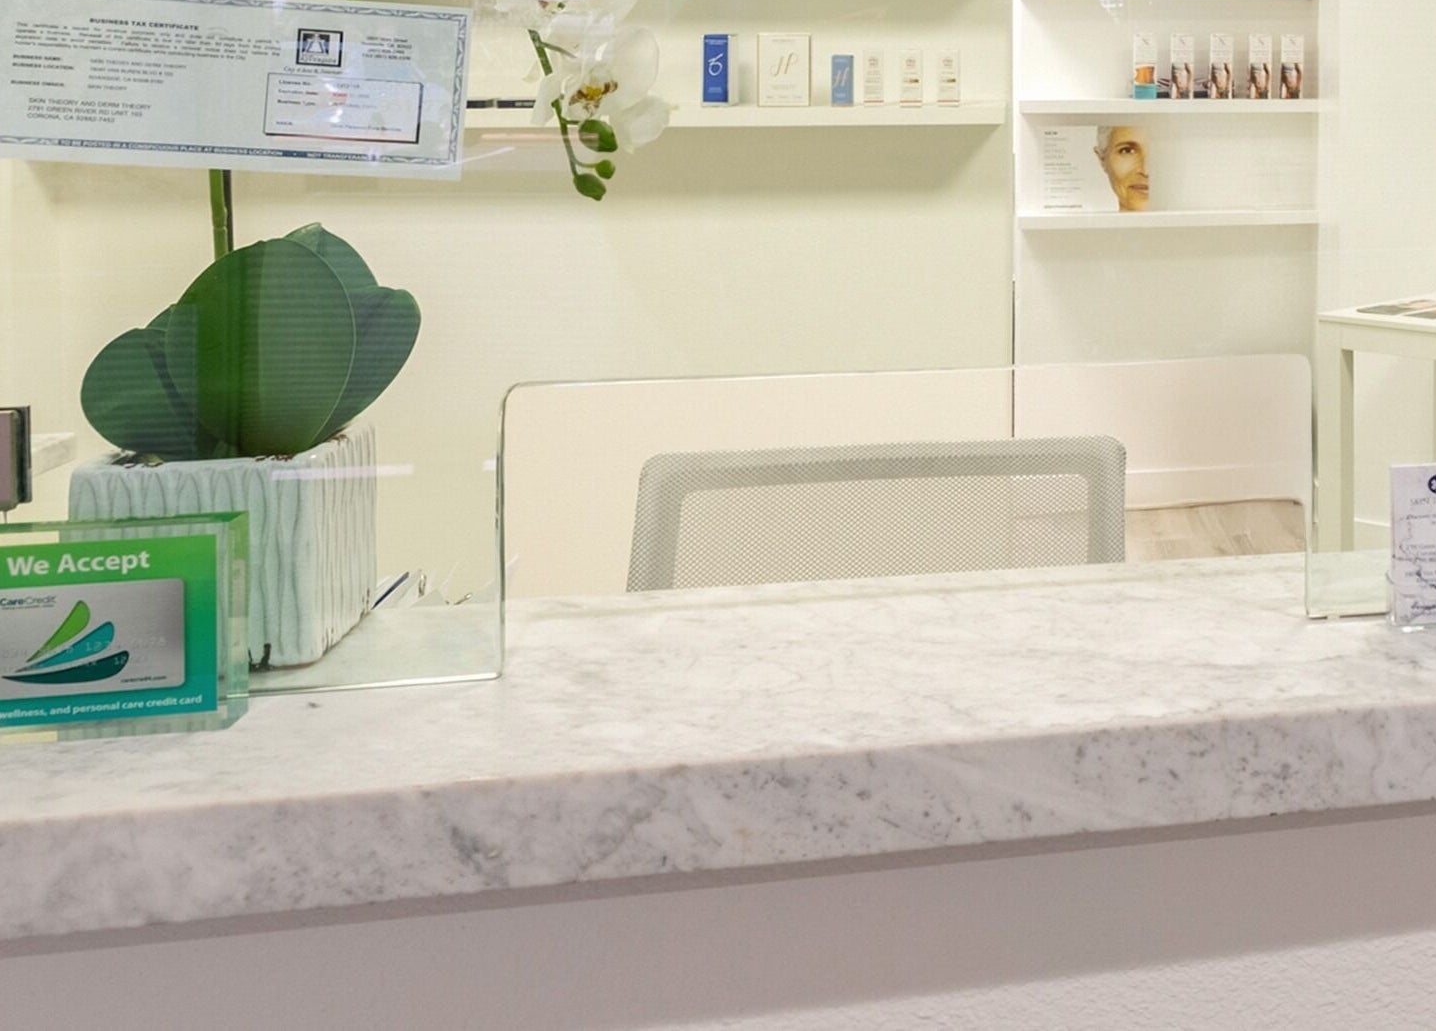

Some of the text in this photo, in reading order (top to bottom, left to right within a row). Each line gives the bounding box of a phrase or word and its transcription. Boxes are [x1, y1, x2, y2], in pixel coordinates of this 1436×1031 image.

[89, 17, 129, 26] BUSINESS
[148, 21, 199, 31] CERTIFICATE
[48, 98, 79, 106] THEORY
[121, 103, 151, 111] THEORY
[6, 551, 150, 577] We Accept
[0, 595, 56, 606] CareCredit
[0, 694, 203, 720] wellness, and personal care credit card
